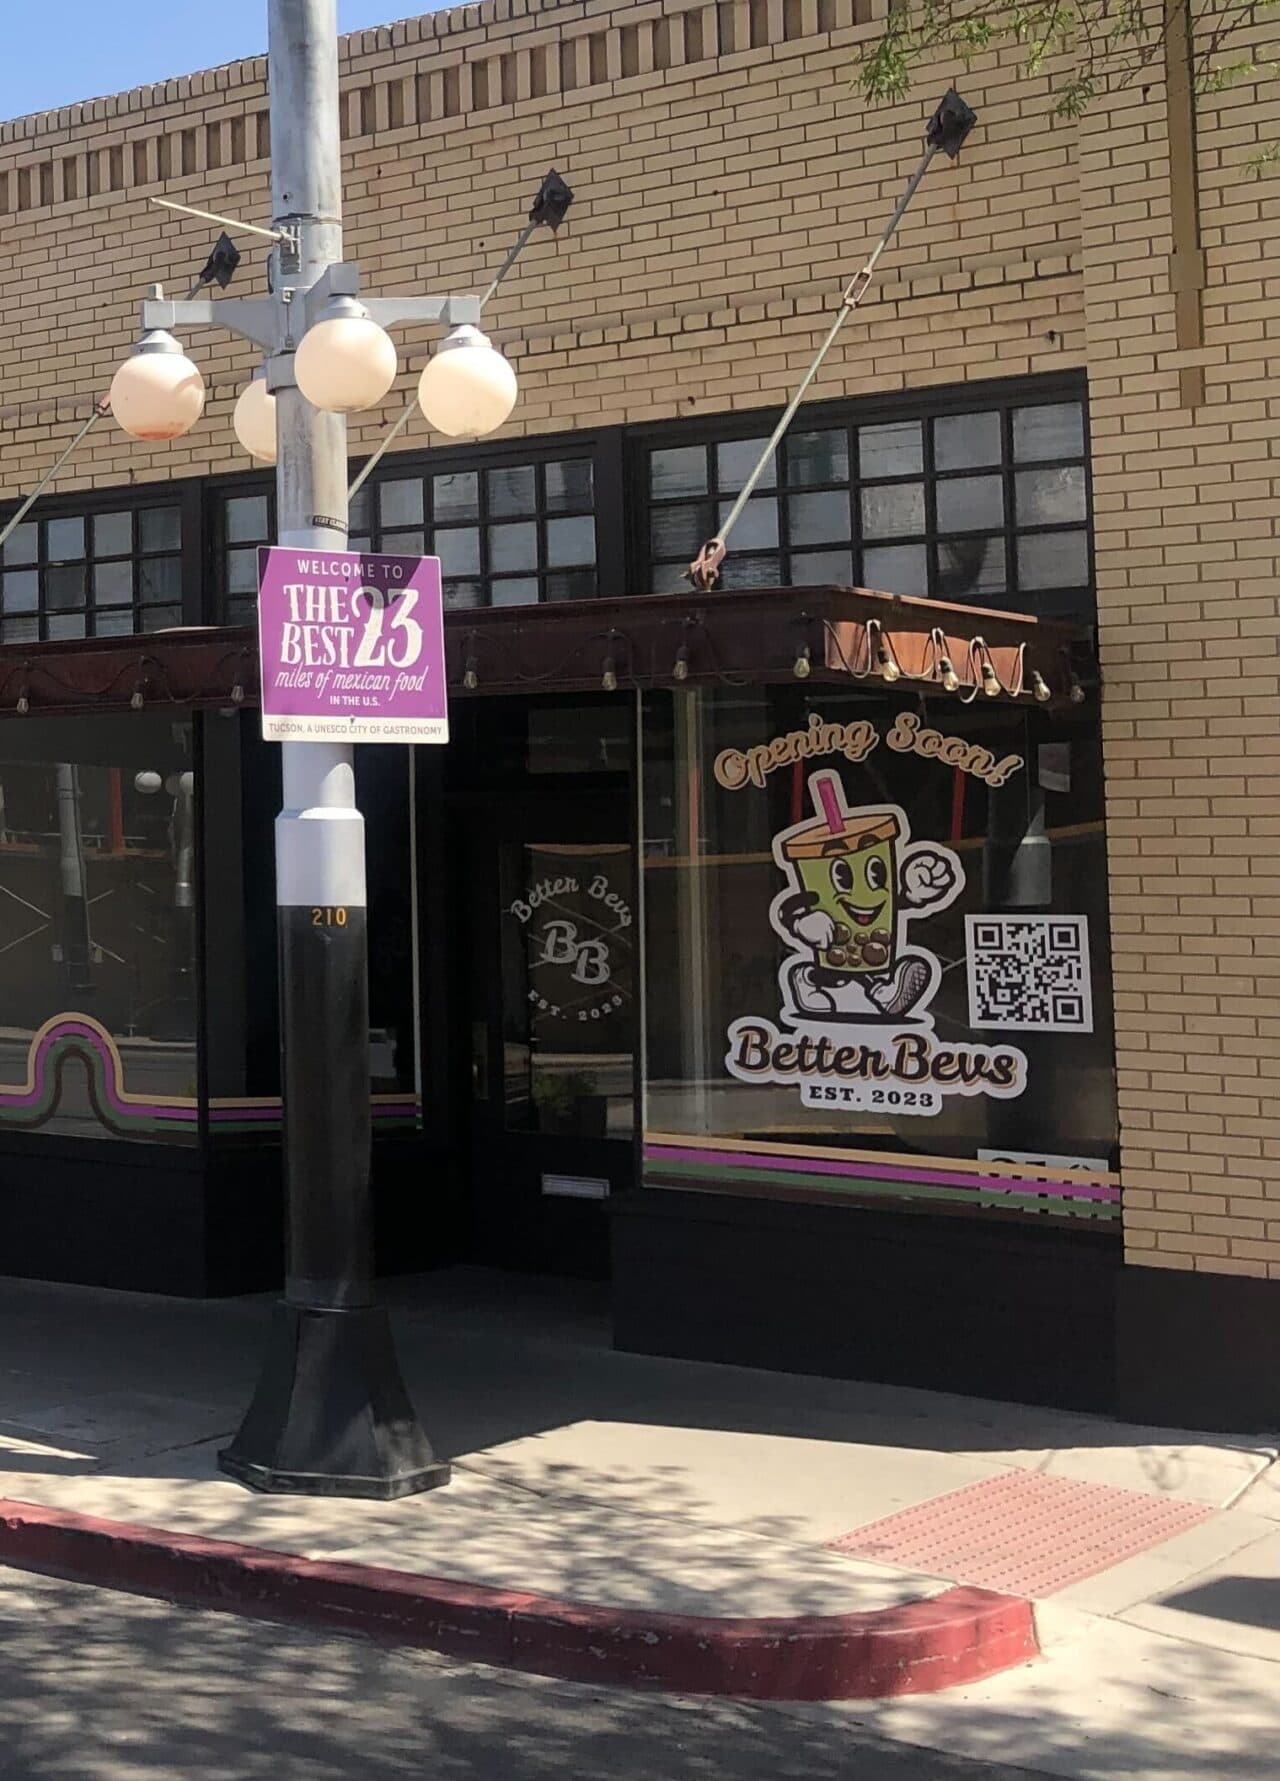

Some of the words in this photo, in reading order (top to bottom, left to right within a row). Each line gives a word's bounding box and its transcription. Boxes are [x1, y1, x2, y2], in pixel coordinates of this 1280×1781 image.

[297, 559, 376, 578] WELCOME
[382, 564, 403, 579] TO
[283, 584, 350, 623] THE
[280, 622, 354, 668] BEST
[351, 586, 424, 668] 23
[275, 662, 313, 689] miles
[315, 669, 333, 699] of
[332, 671, 391, 691] mexican
[389, 665, 429, 702] food
[330, 695, 342, 705] IN
[342, 696, 361, 706] THE
[363, 697, 381, 707] U.S.
[307, 724, 313, 733] A
[314, 724, 348, 734] UNESCO
[349, 725, 368, 734] CITY
[370, 726, 381, 735] OF
[383, 726, 442, 736] GASTRONOMY
[713, 713, 879, 790] Opening
[886, 711, 1024, 787] Soon!
[311, 907, 346, 926] 210
[510, 877, 579, 923] Better
[733, 1025, 890, 1080] Better
[890, 1033, 1017, 1088] Bevs
[809, 1086, 862, 1103] EST.
[871, 1089, 934, 1107] 2023
